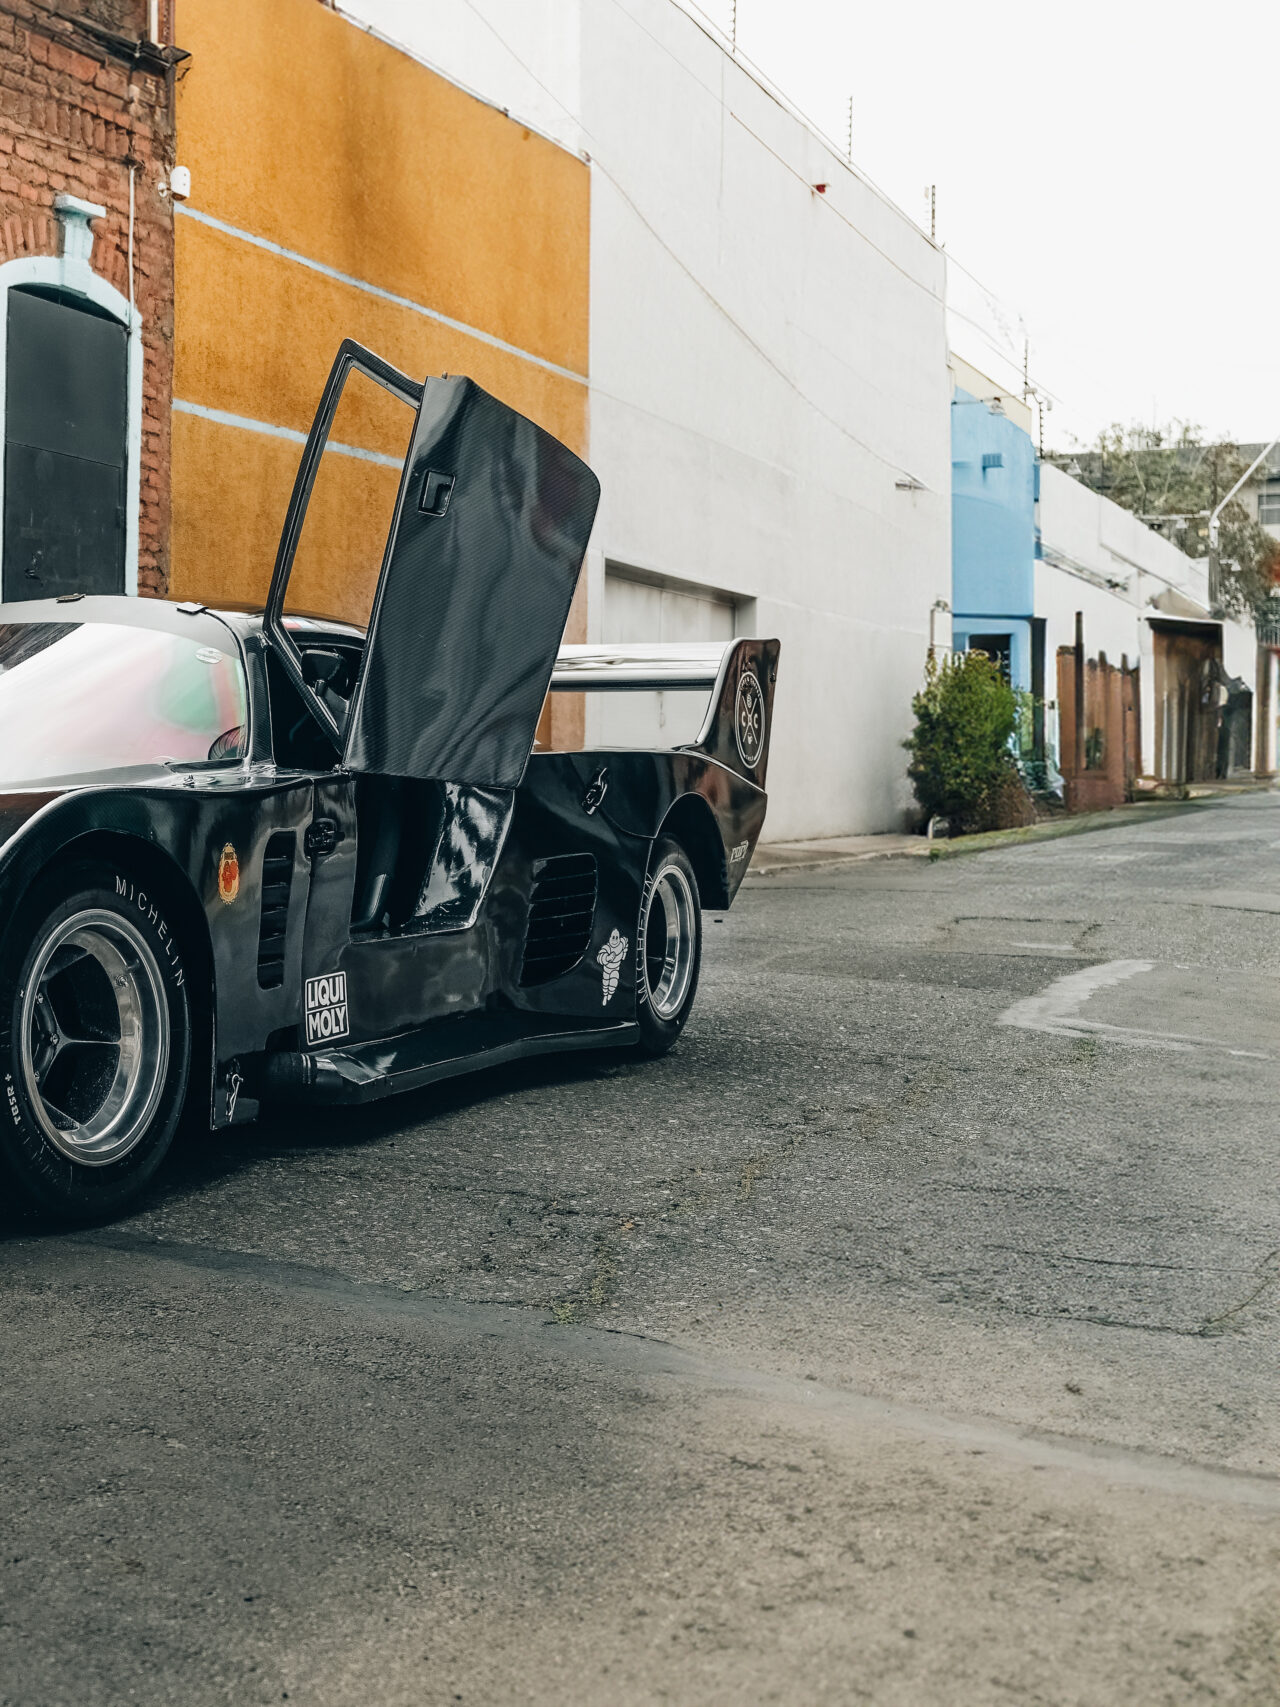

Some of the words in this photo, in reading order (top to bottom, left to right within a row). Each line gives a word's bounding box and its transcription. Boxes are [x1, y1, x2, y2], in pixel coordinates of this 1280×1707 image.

[115, 875, 185, 986] MICHELIN
[308, 975, 344, 1008] LIQUI
[308, 1006, 346, 1040] MOLY
